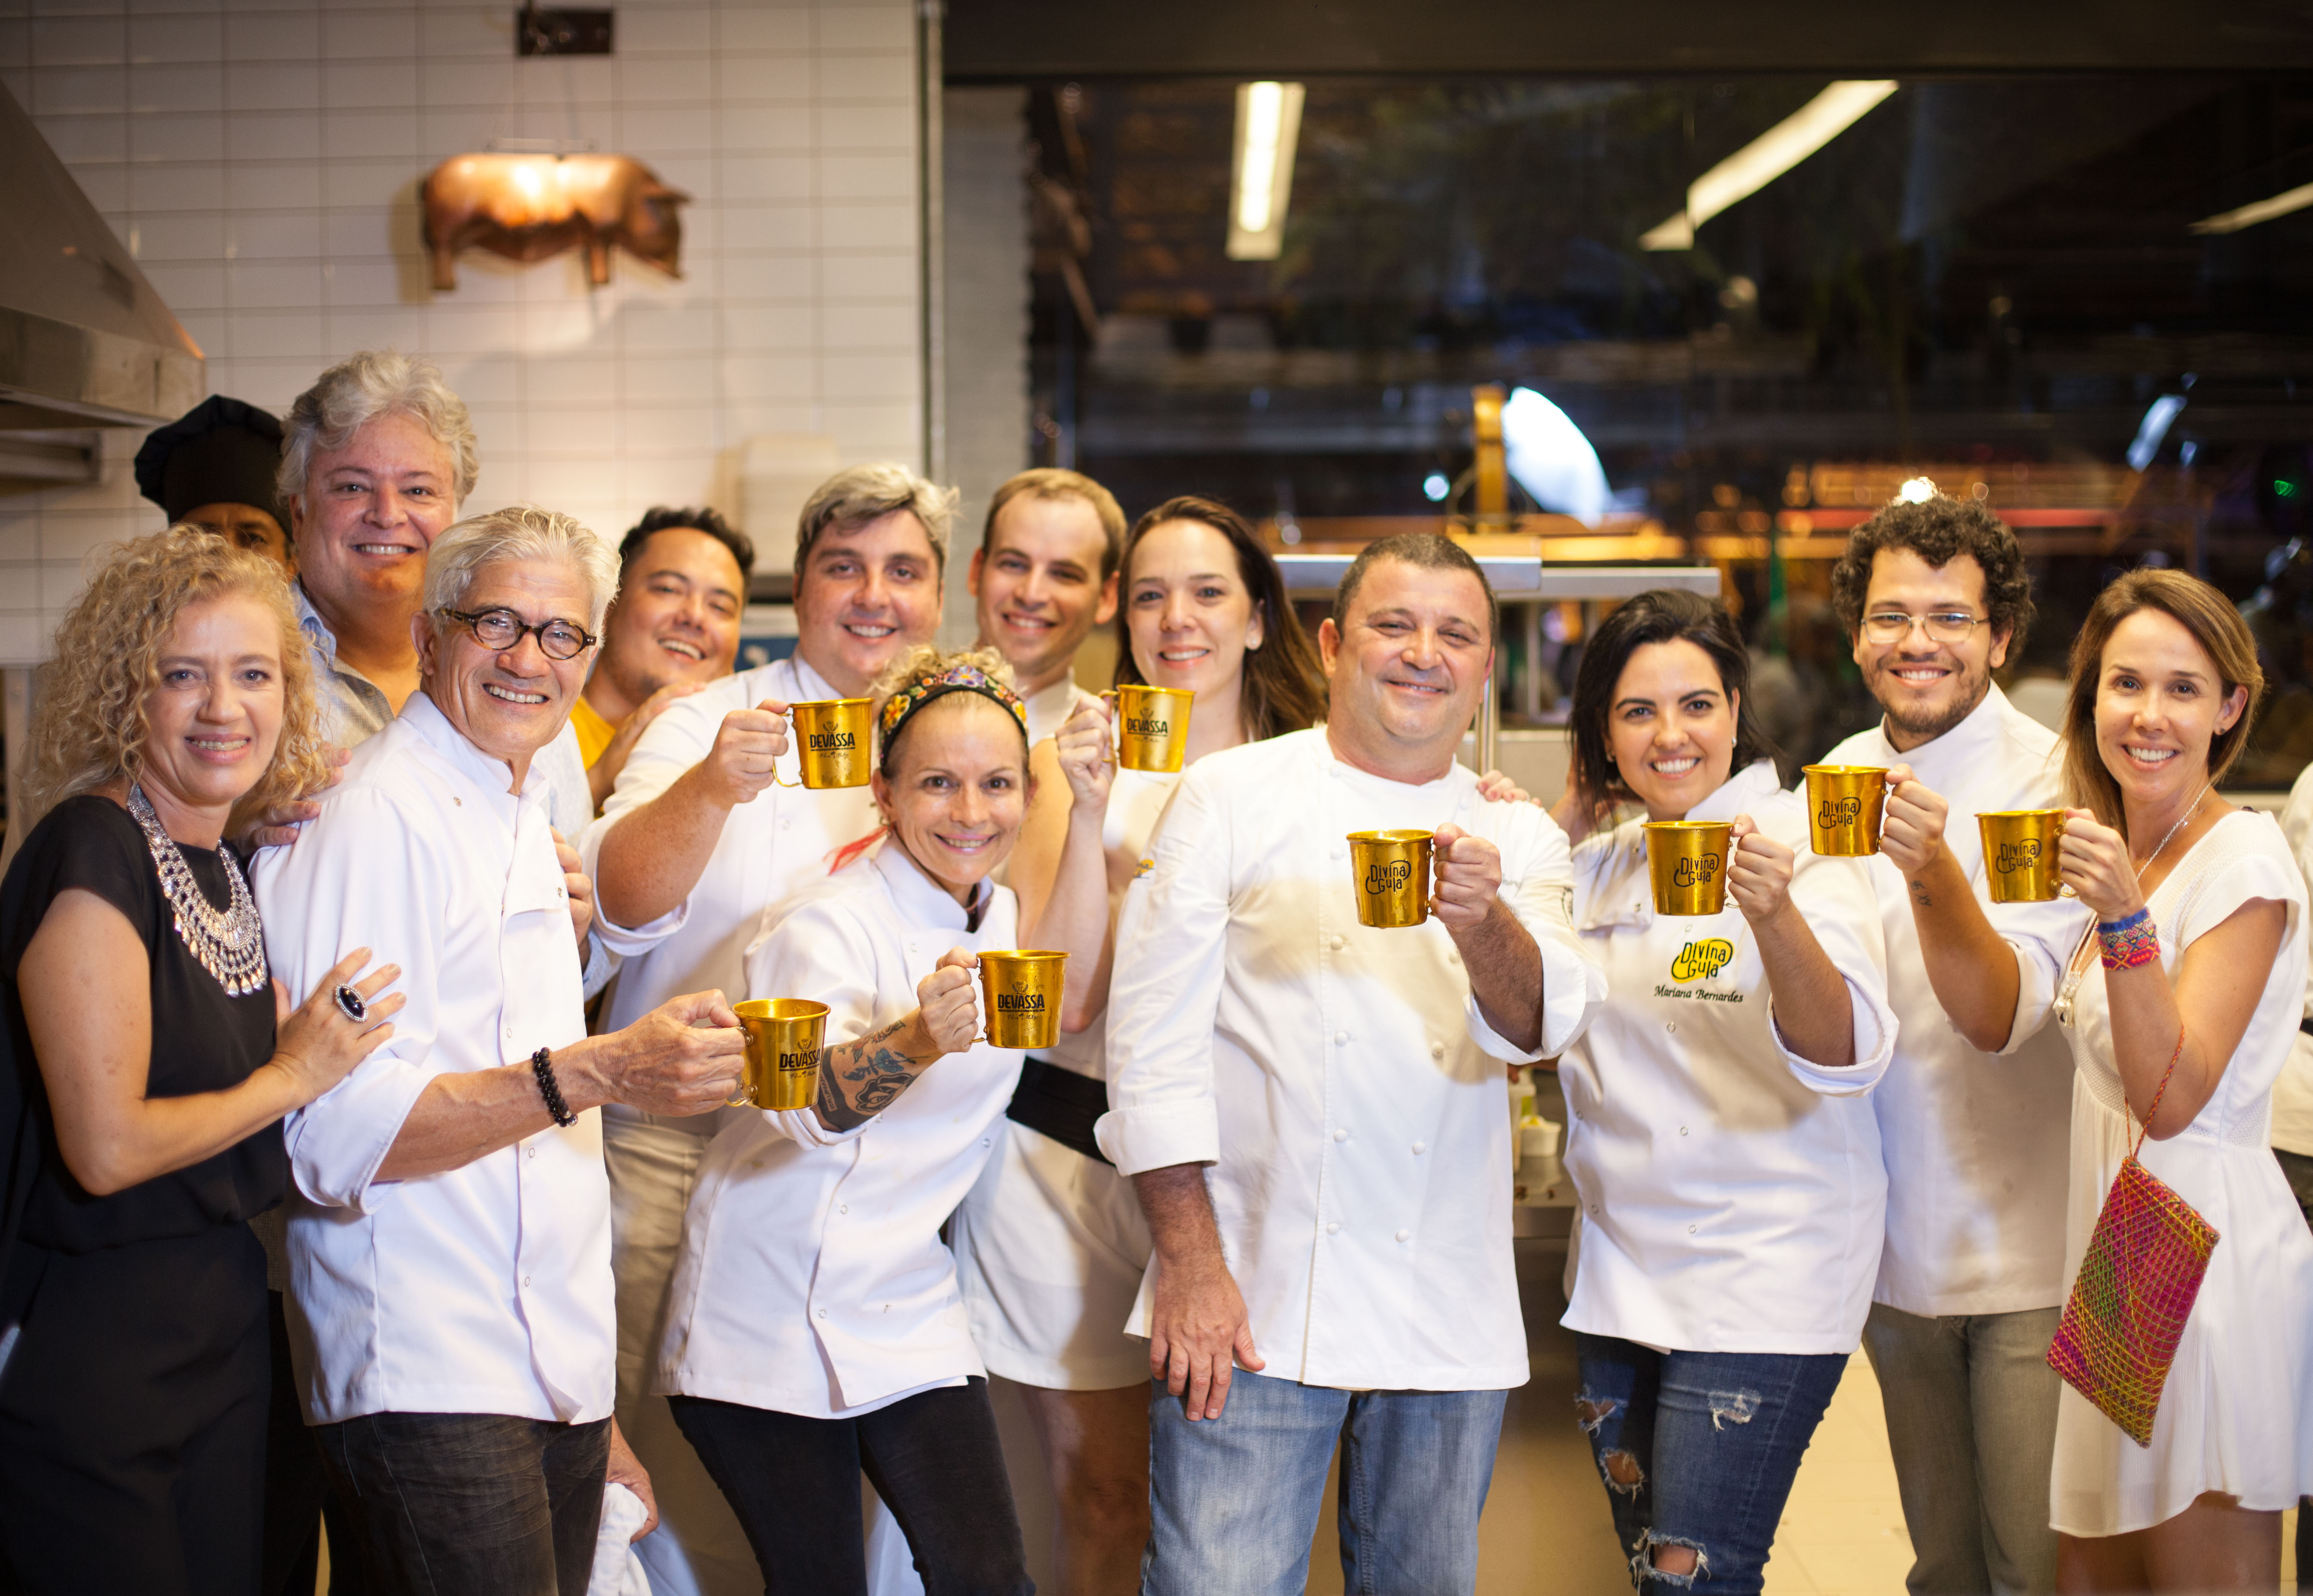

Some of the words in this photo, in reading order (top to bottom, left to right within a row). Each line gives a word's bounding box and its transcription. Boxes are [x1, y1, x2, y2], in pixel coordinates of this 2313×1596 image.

[1127, 718, 1168, 733] DEVASSA
[809, 732, 855, 748] DEVASSA
[1823, 800, 1856, 817] Divina
[1830, 814, 1853, 827] Gula
[2000, 844, 2036, 861] Divina
[1681, 857, 1714, 875] Divina
[2008, 856, 2033, 871] Gula
[1370, 864, 1406, 882] Divina
[1688, 871, 1711, 885] Gula
[1378, 877, 1402, 892] Gula
[1681, 942, 1726, 963] Divina
[1688, 960, 1719, 979] Gula
[998, 994, 1045, 1009] DEVASSA
[1654, 984, 1692, 999] Mariana
[1695, 989, 1744, 1003] Bernardes
[779, 1048, 820, 1068] DEVASSA
